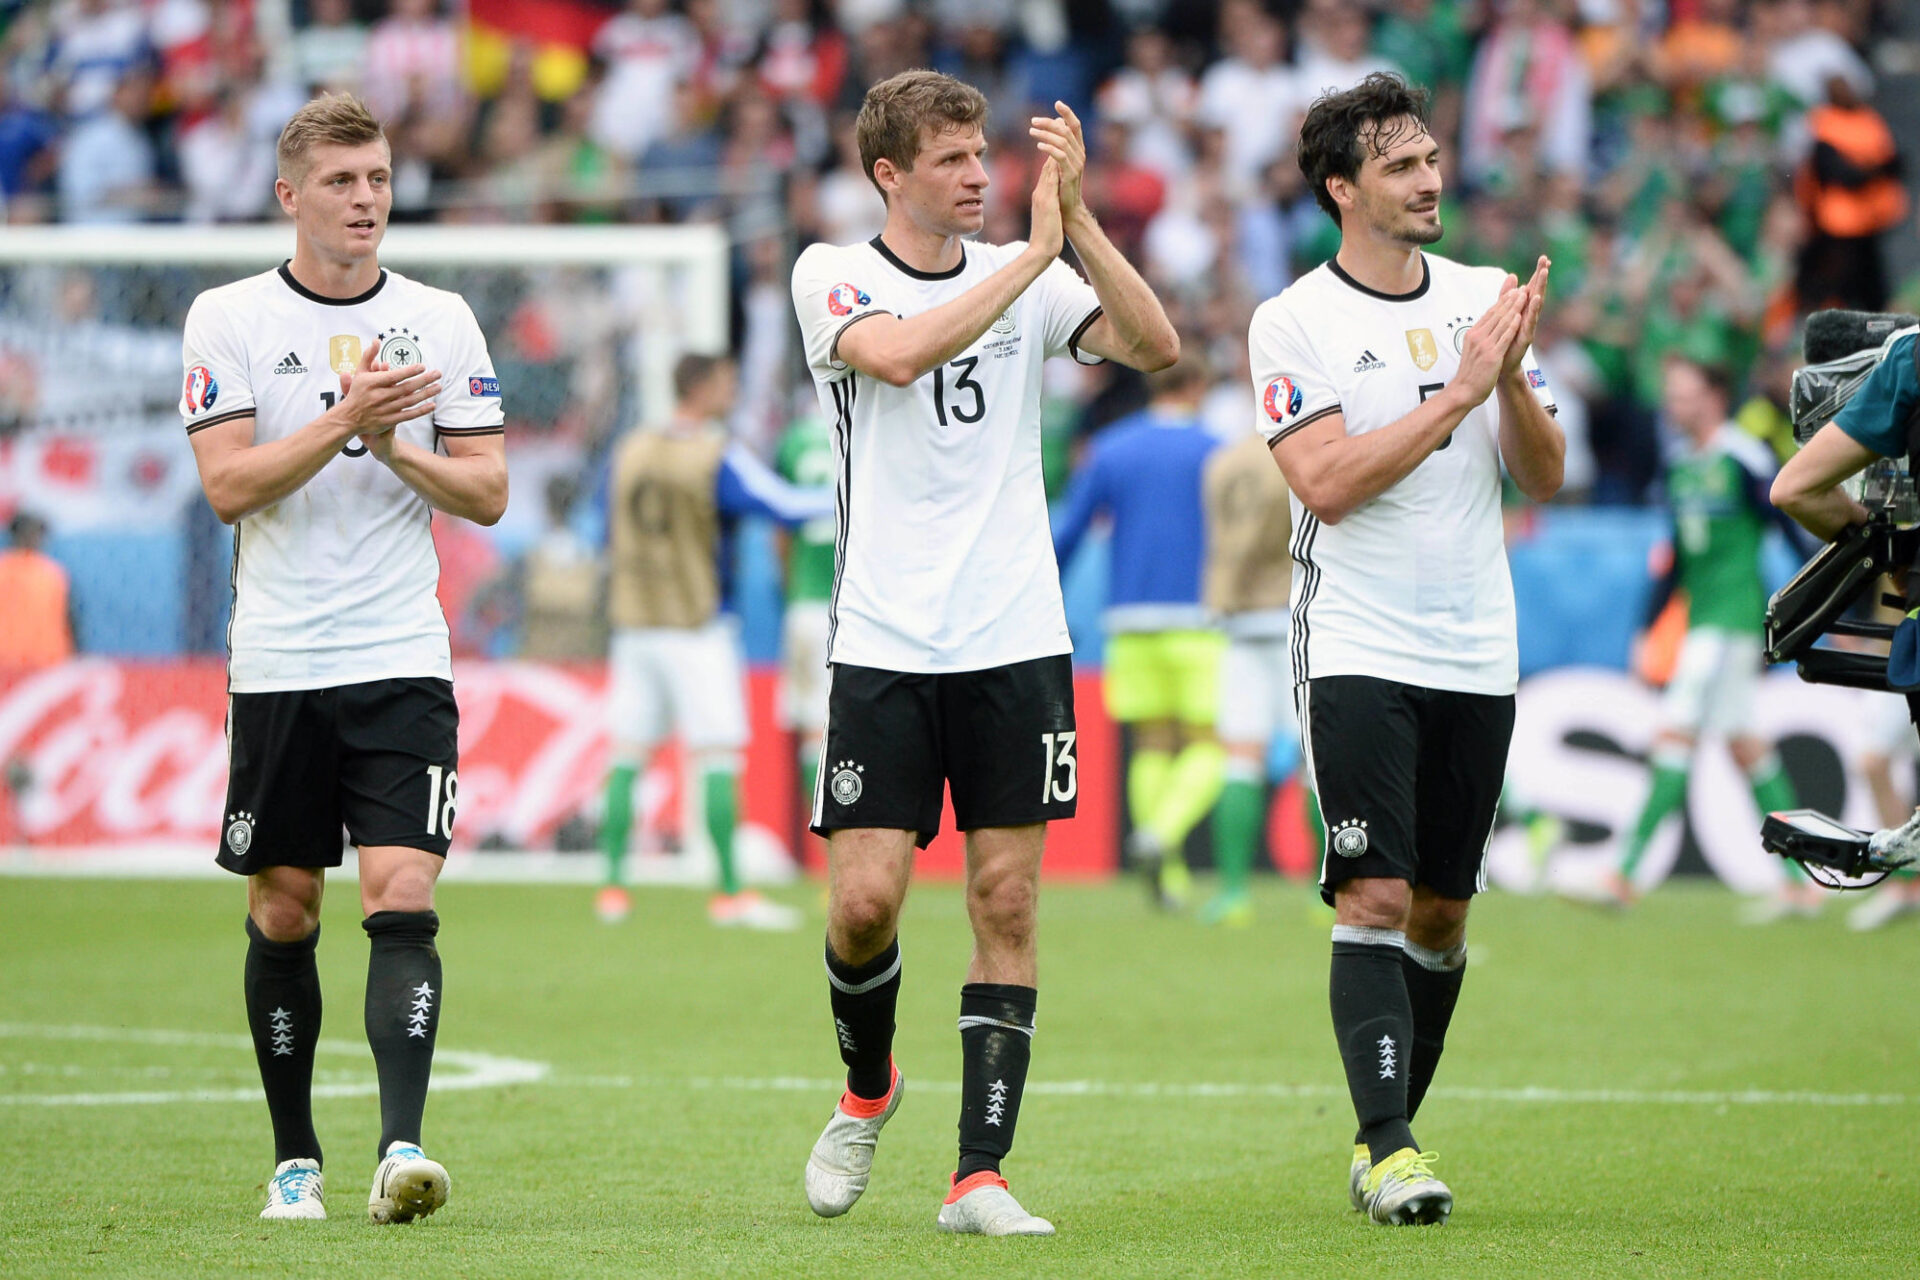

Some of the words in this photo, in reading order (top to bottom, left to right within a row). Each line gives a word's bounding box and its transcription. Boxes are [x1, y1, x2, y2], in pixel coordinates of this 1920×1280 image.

[273, 365, 309, 375] adidas
[483, 382, 500, 393] RES
[1353, 361, 1387, 373] adidas
[933, 355, 986, 427] 13
[1041, 731, 1077, 804] 13
[426, 765, 459, 840] 18
